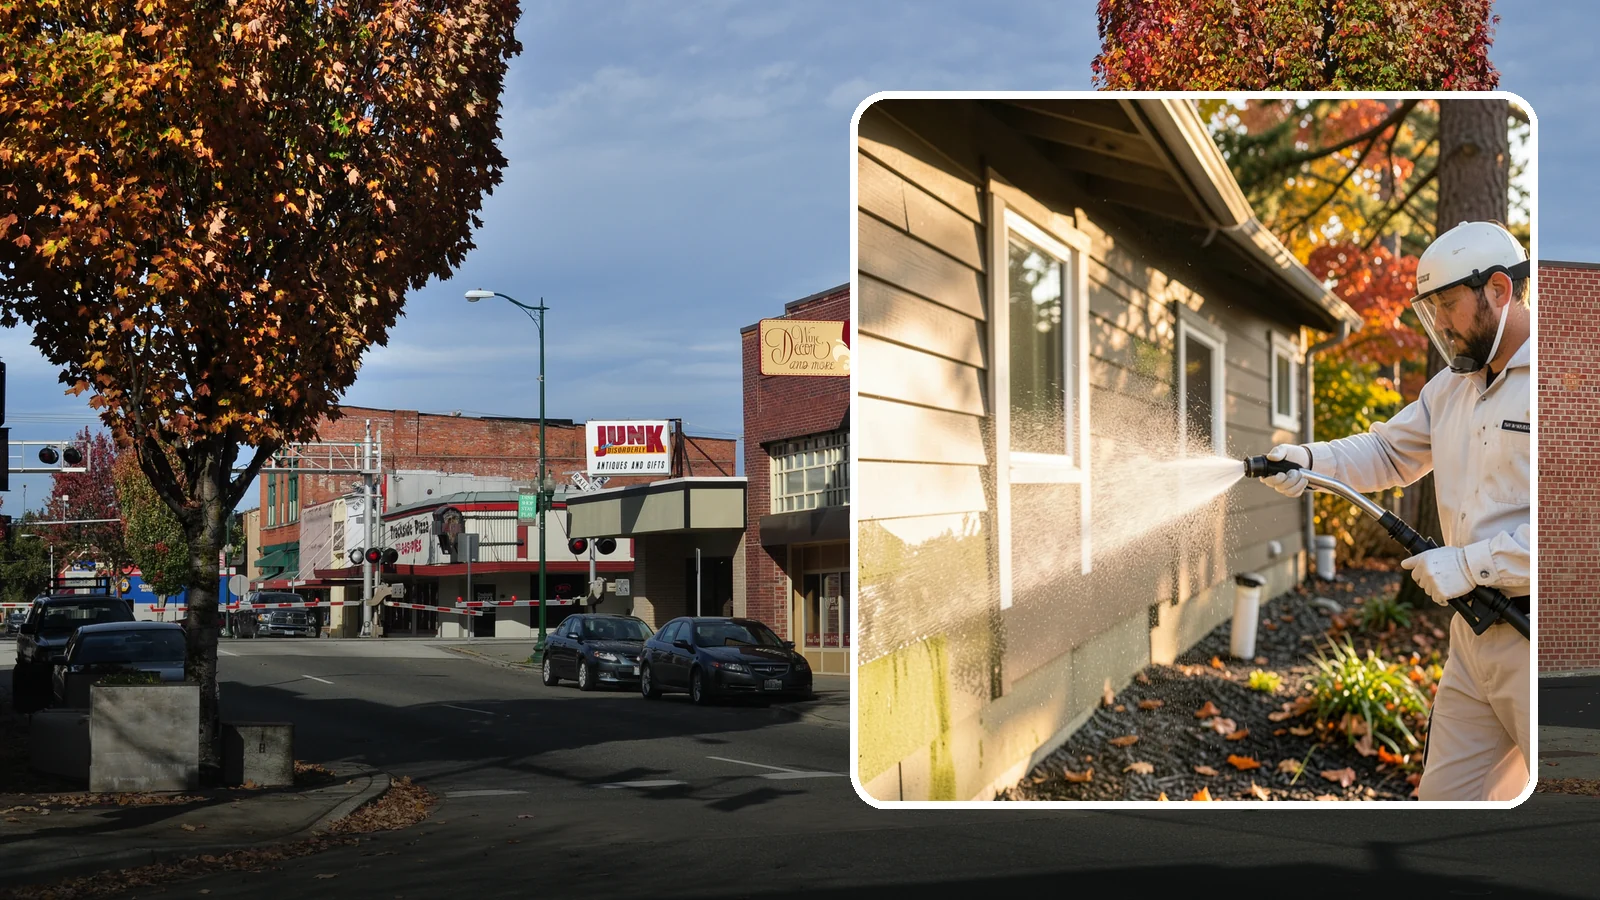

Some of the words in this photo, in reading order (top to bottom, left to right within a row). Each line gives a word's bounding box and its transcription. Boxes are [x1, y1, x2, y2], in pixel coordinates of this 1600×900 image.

[595, 425, 664, 457] JUNK
[607, 445, 645, 454] DISORDERLY
[597, 461, 628, 470] ANTIQUES
[631, 461, 643, 469] AND
[647, 460, 665, 469] GIFTS
[415, 519, 429, 534] Pizza
